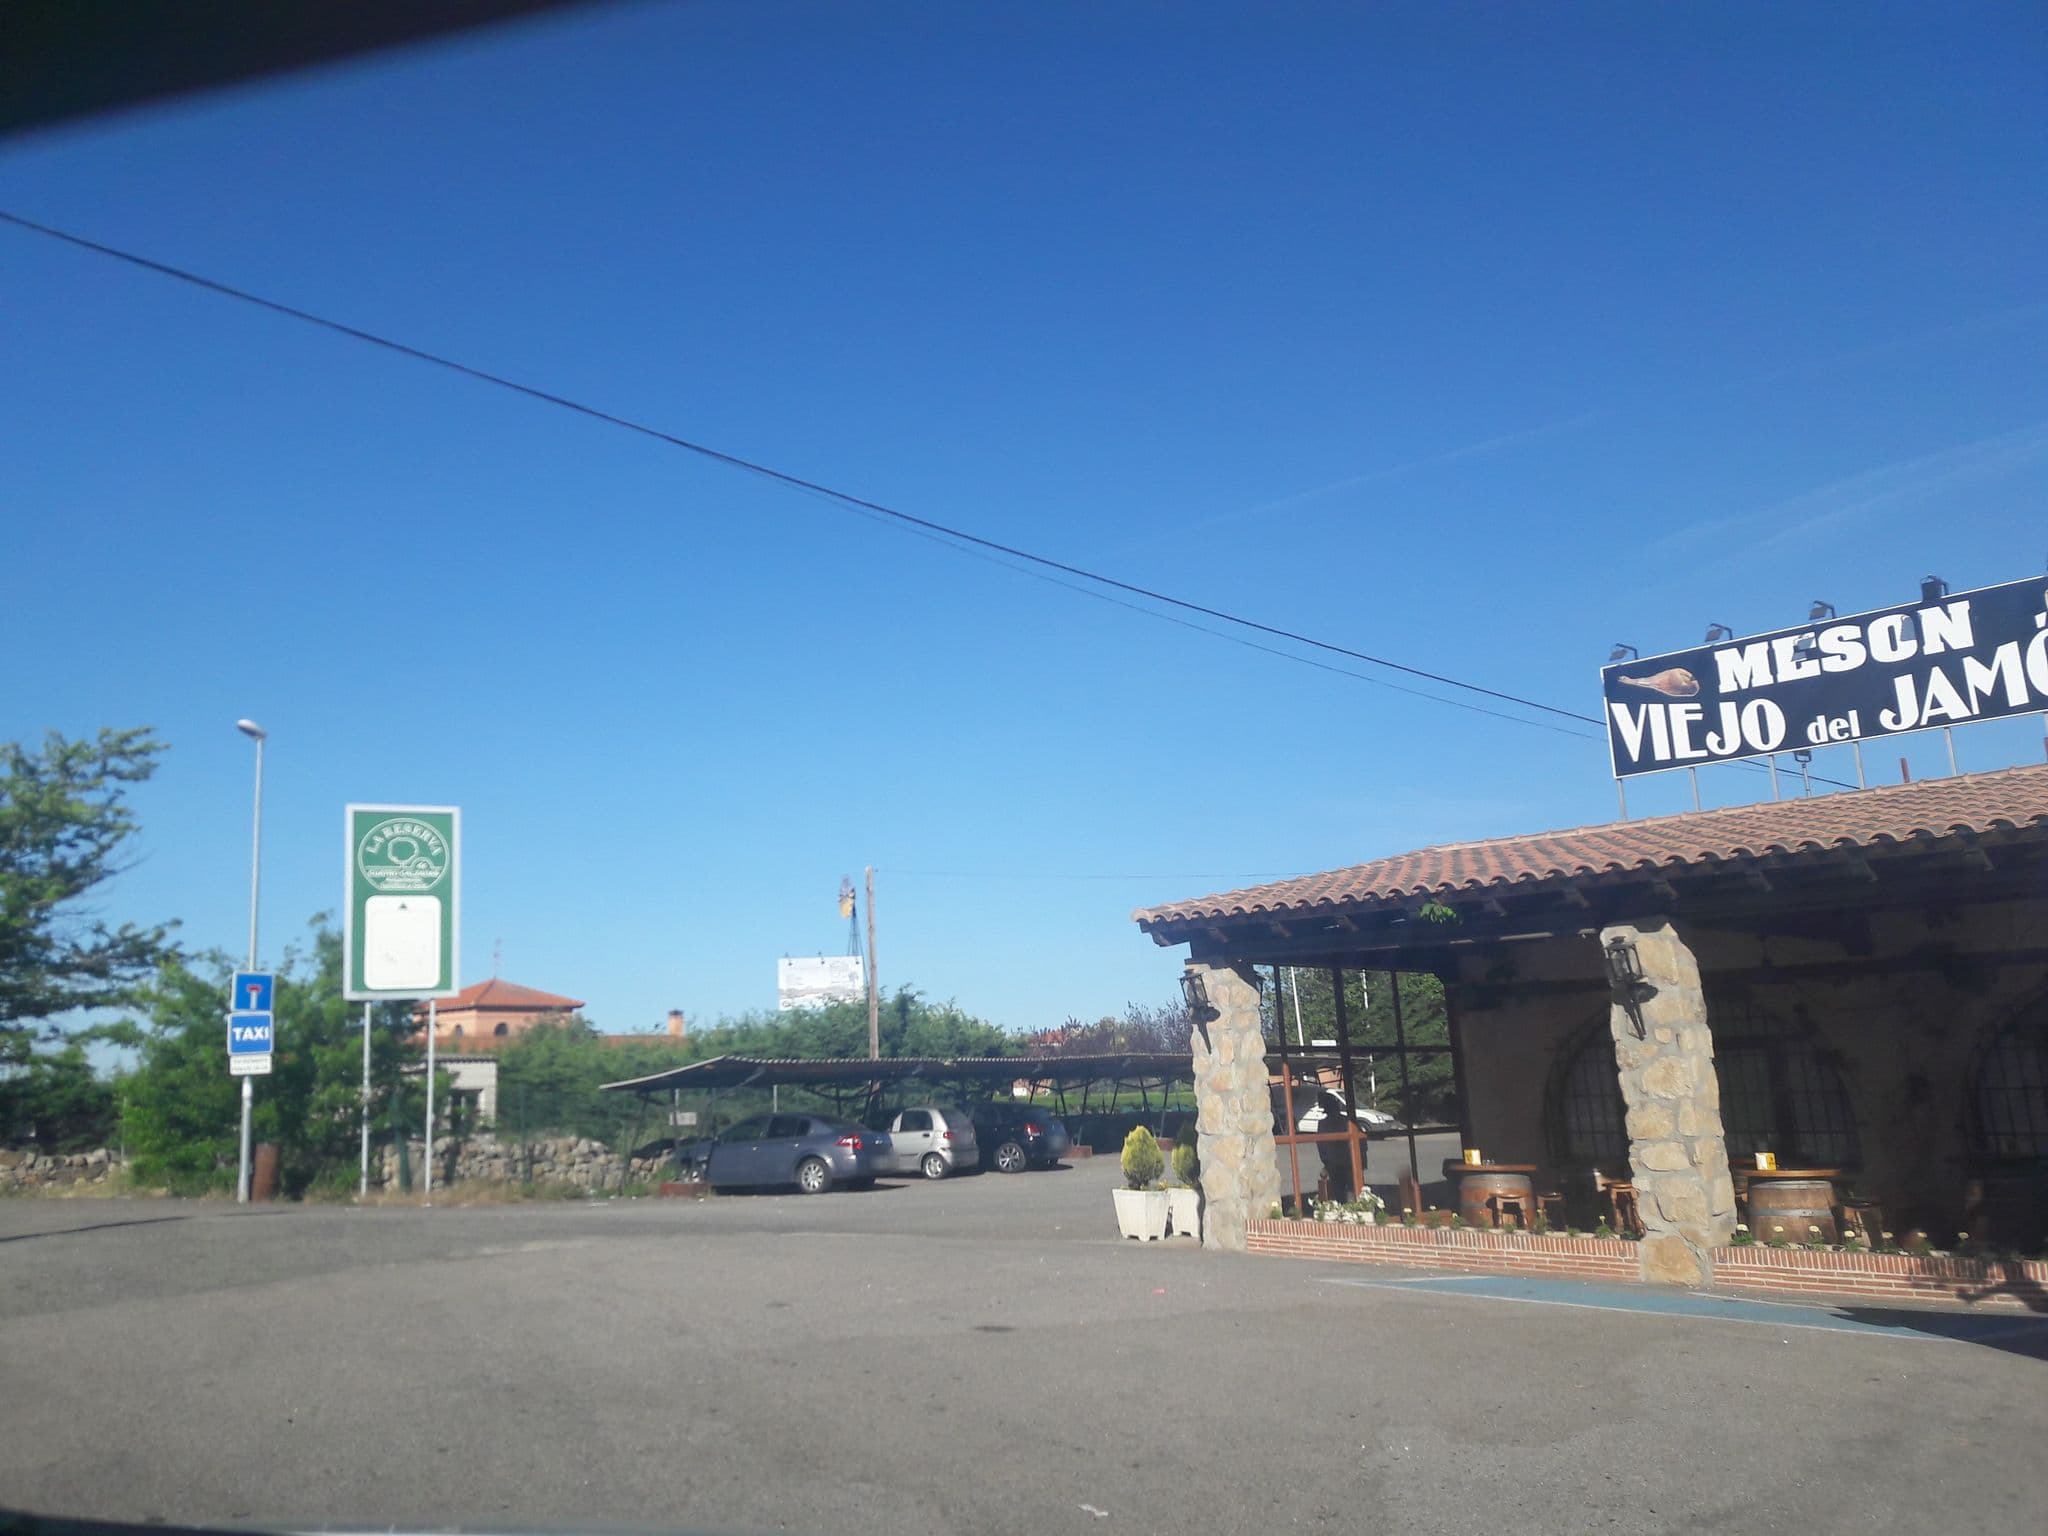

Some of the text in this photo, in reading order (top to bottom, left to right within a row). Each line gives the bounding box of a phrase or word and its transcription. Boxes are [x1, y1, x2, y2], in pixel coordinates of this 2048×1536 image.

[1713, 600, 1976, 693] MESON
[1610, 698, 1787, 763] VIEJO
[1806, 709, 1860, 744] del
[232, 1026, 269, 1041] TAXI
